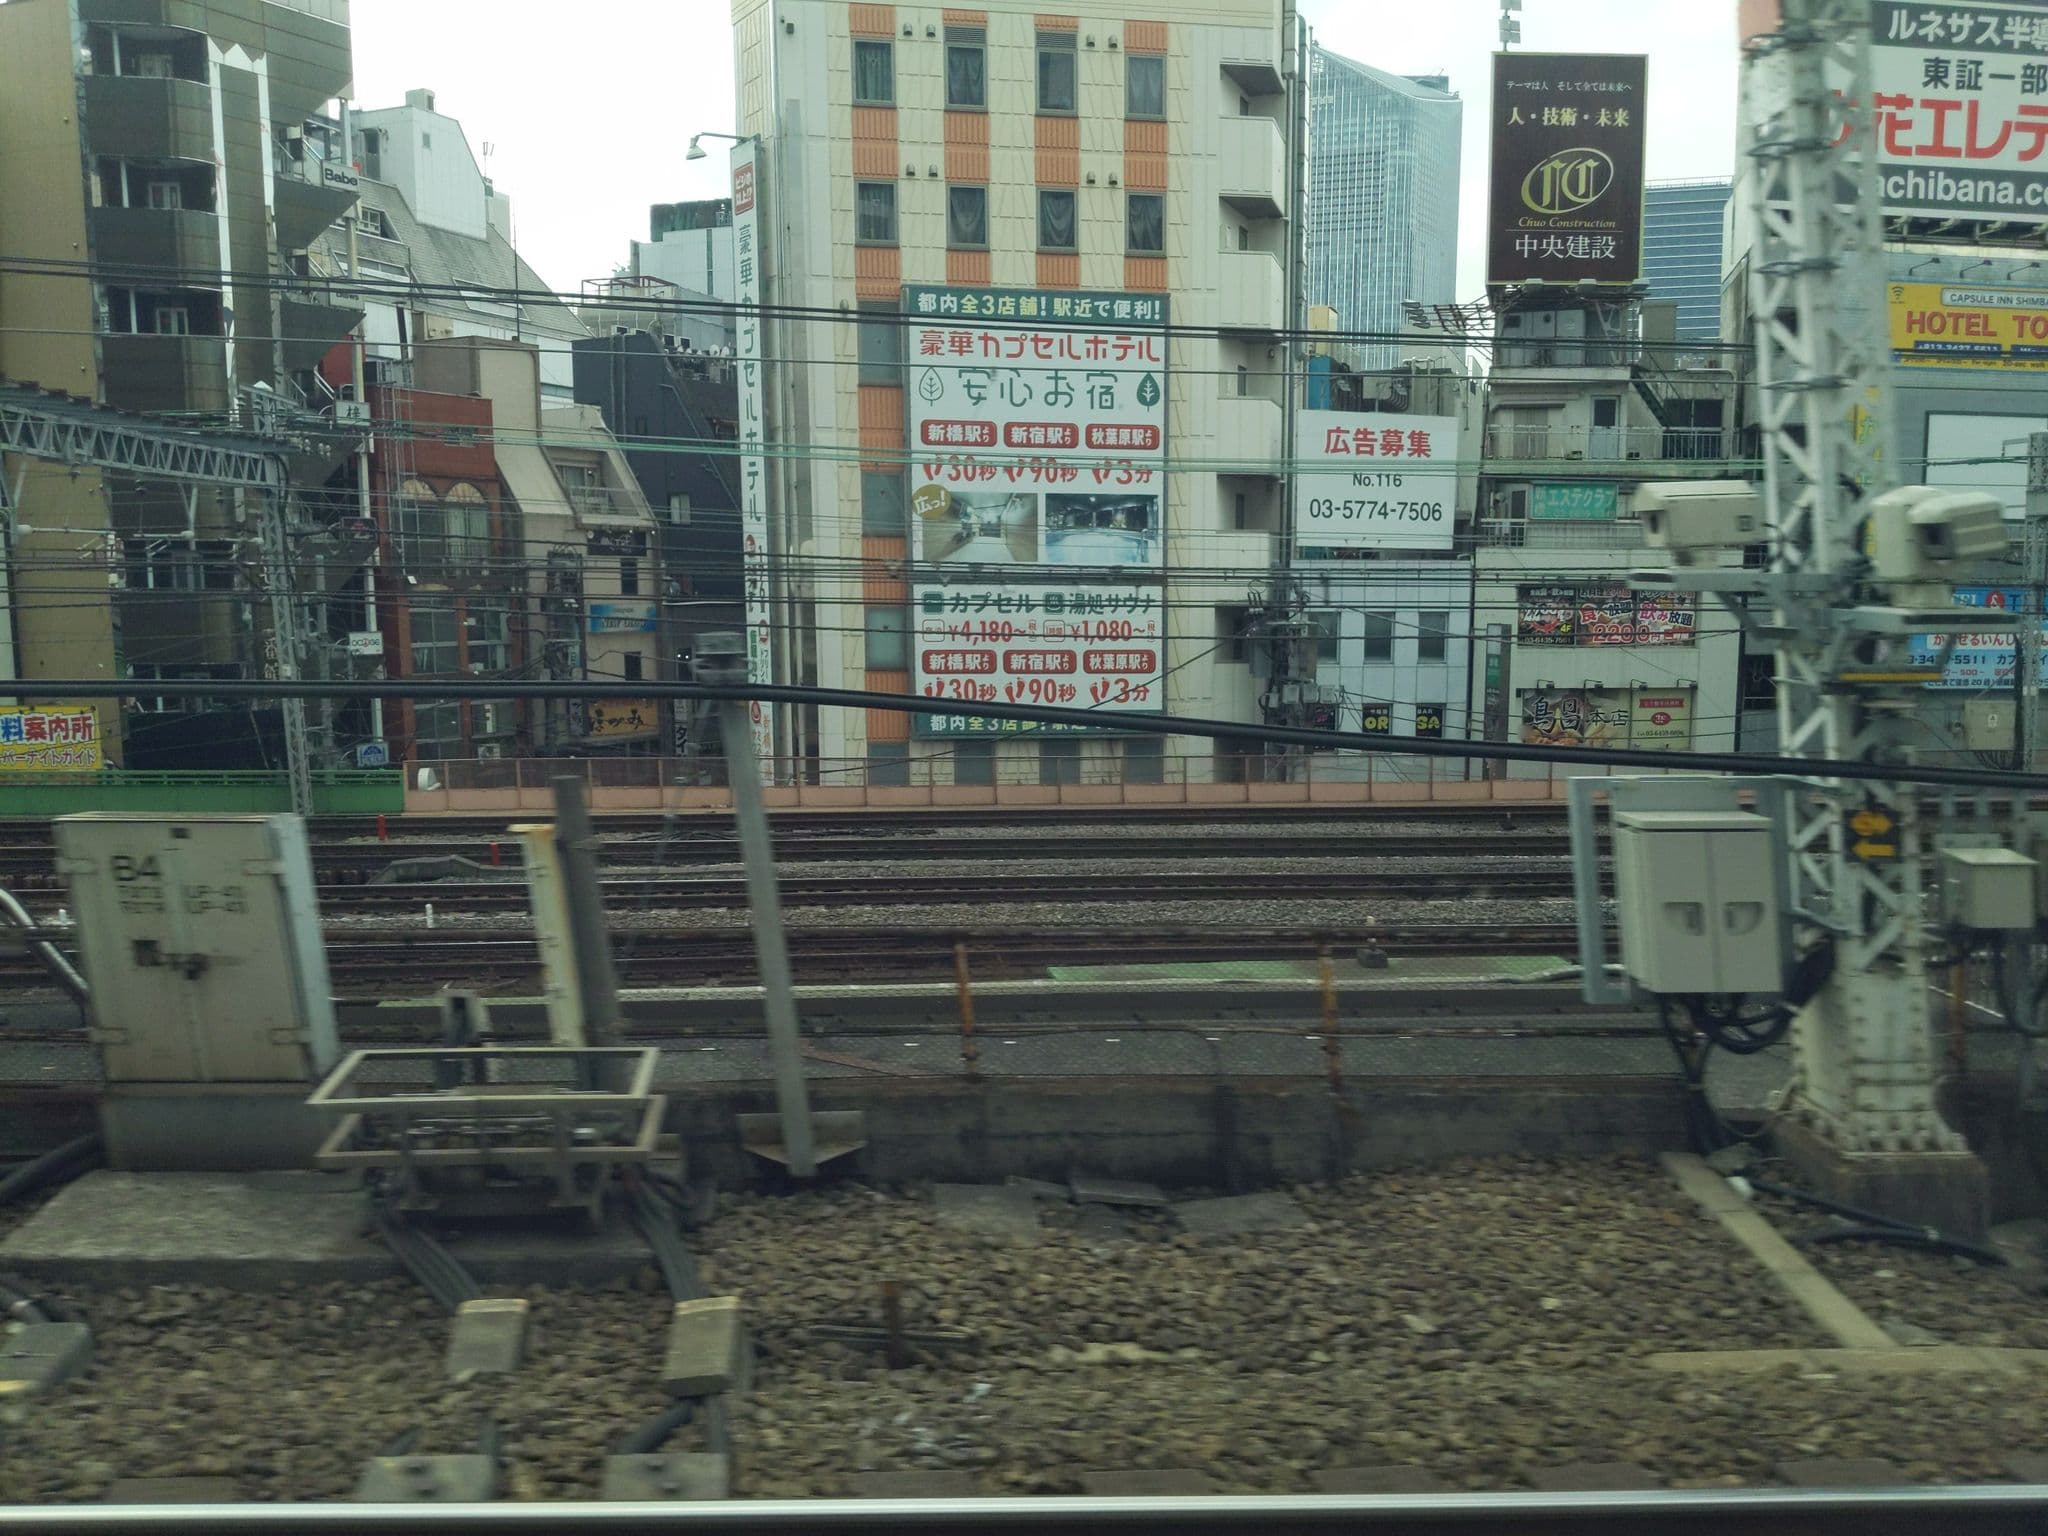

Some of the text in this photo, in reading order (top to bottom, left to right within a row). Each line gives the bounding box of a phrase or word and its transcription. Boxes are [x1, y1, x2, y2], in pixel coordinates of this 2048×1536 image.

[324, 168, 358, 186] Babe
[1519, 216, 1616, 229] Chuo Construction
[1515, 234, 1616, 260] 中央建設
[1950, 293, 1994, 304] CAPSULE
[1996, 296, 2013, 304] INN
[1906, 311, 1998, 338] HOTEL
[919, 329, 1161, 363] 豪華カプセルホテル
[957, 368, 1119, 411] 安心お宿
[1324, 426, 1432, 458] 広告募集
[1352, 472, 1402, 488] No.116
[1309, 498, 1442, 522] 03-5774-7506
[949, 592, 1037, 614] カプセル
[1028, 678, 1077, 704] 90秒
[1113, 678, 1150, 704] 3分
